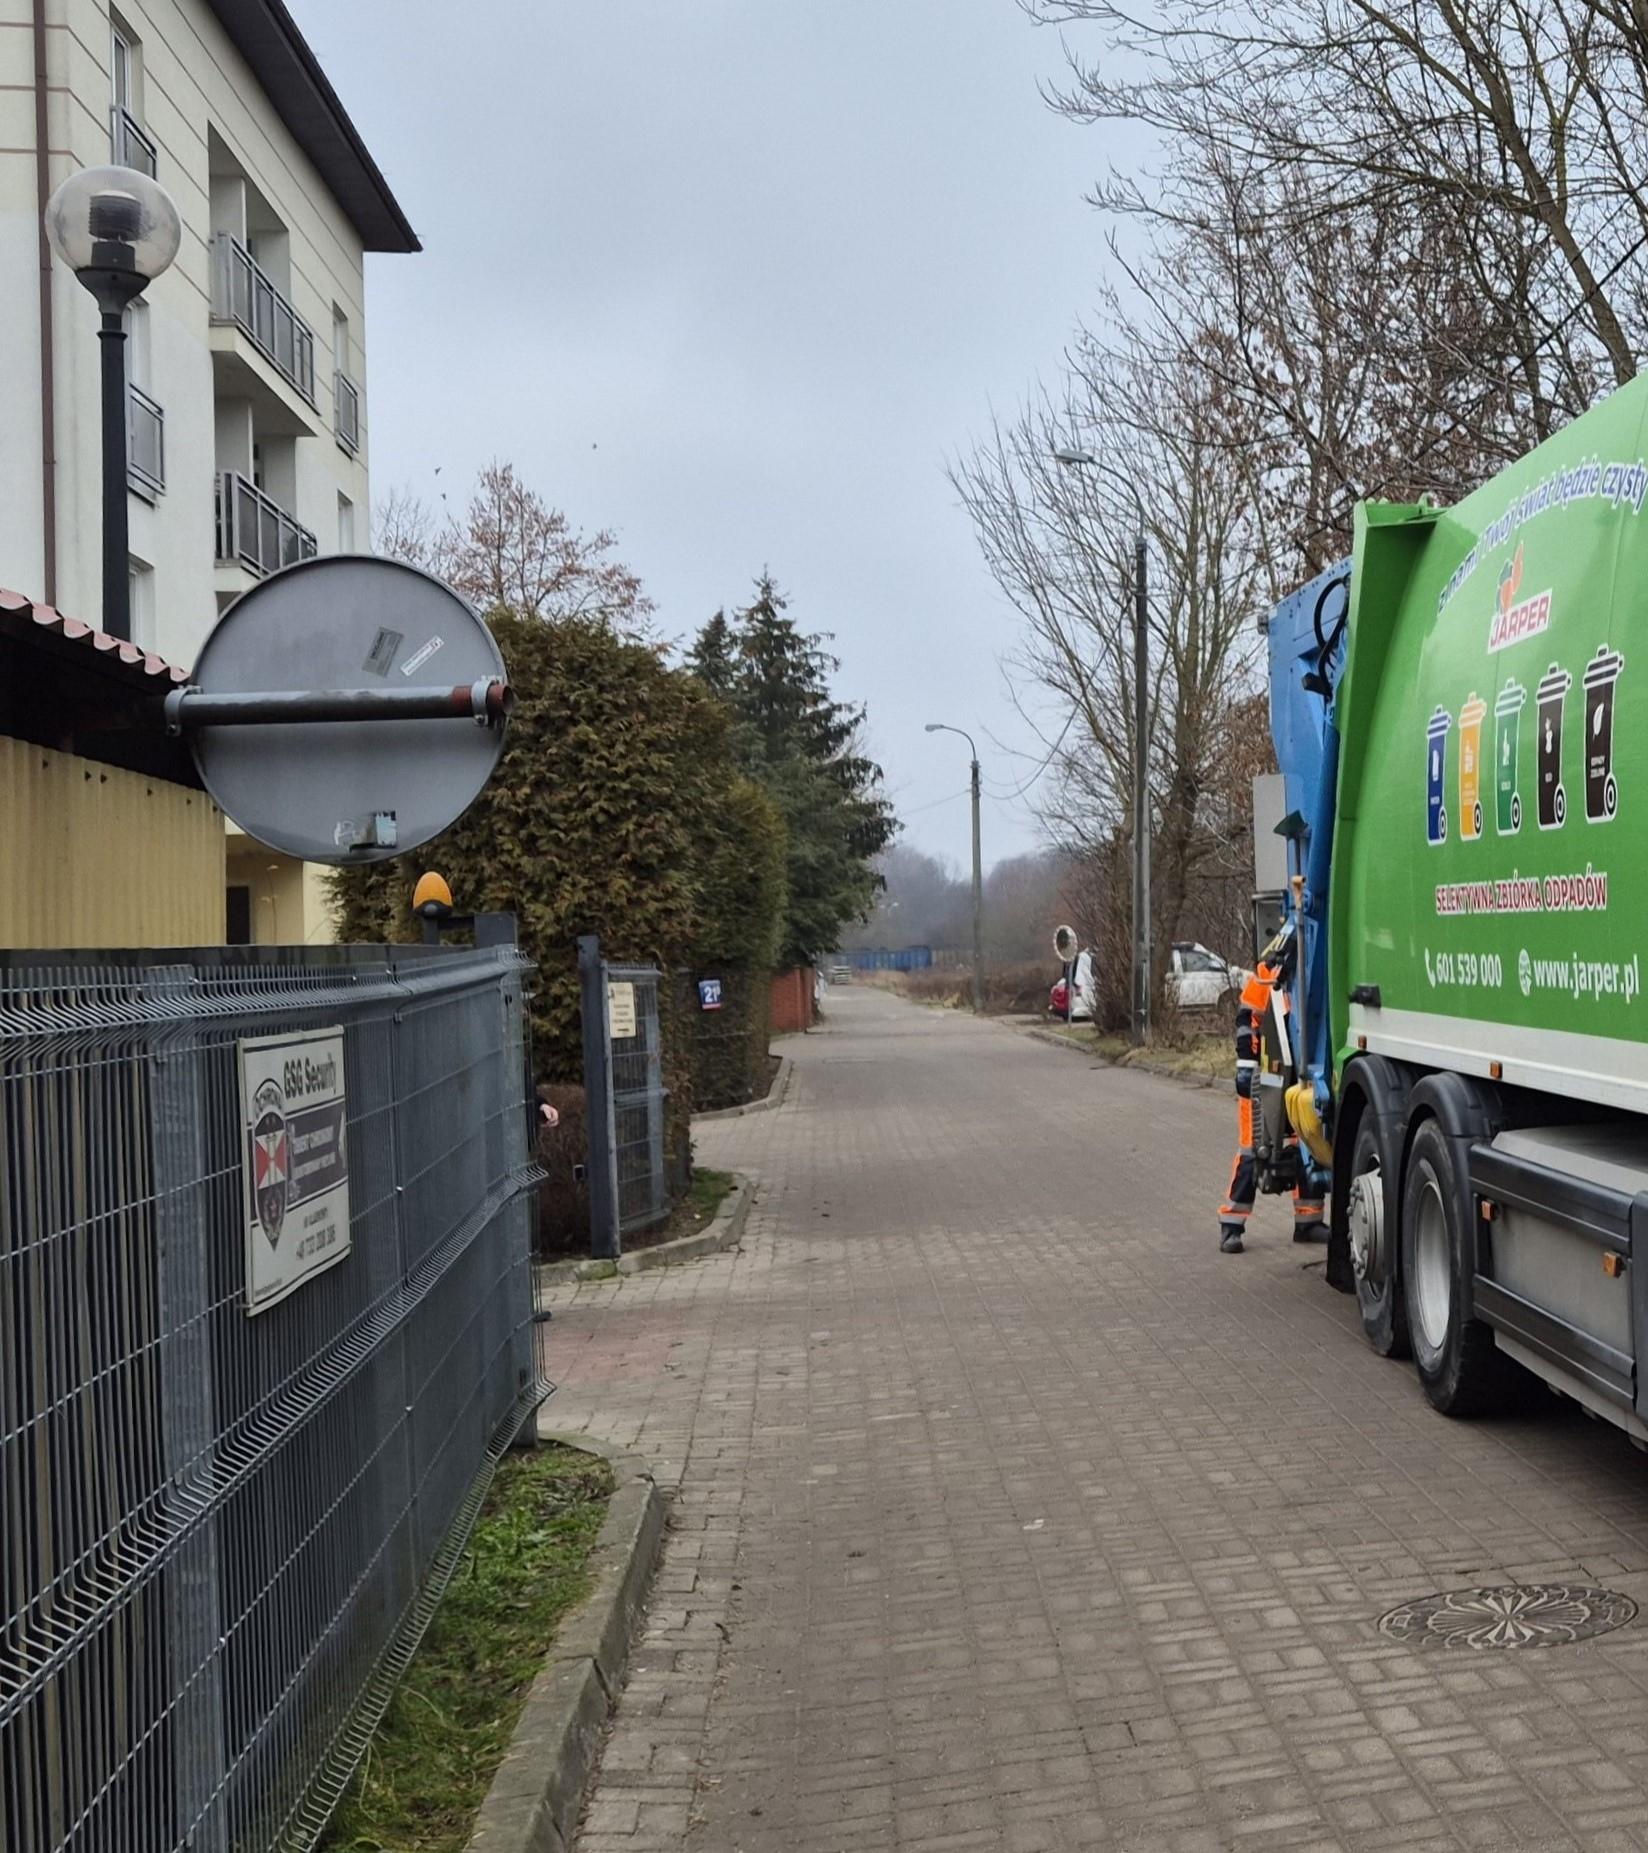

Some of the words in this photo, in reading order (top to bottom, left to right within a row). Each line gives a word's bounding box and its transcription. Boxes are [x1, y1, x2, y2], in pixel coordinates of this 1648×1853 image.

[1554, 455, 1601, 510] będzie
[1490, 595, 1550, 646] JARPER
[1436, 882, 1494, 914] SELEKTYWNA
[1494, 870, 1543, 913] ZBIÓRKA
[1543, 863, 1607, 911] ODPADÓW
[1436, 952, 1456, 984] 601
[1457, 953, 1478, 985] 539
[1480, 954, 1502, 988] 000
[1534, 952, 1640, 1004] www.jarper.pl
[284, 1059, 303, 1099] GSG
[305, 1052, 337, 1095] Security
